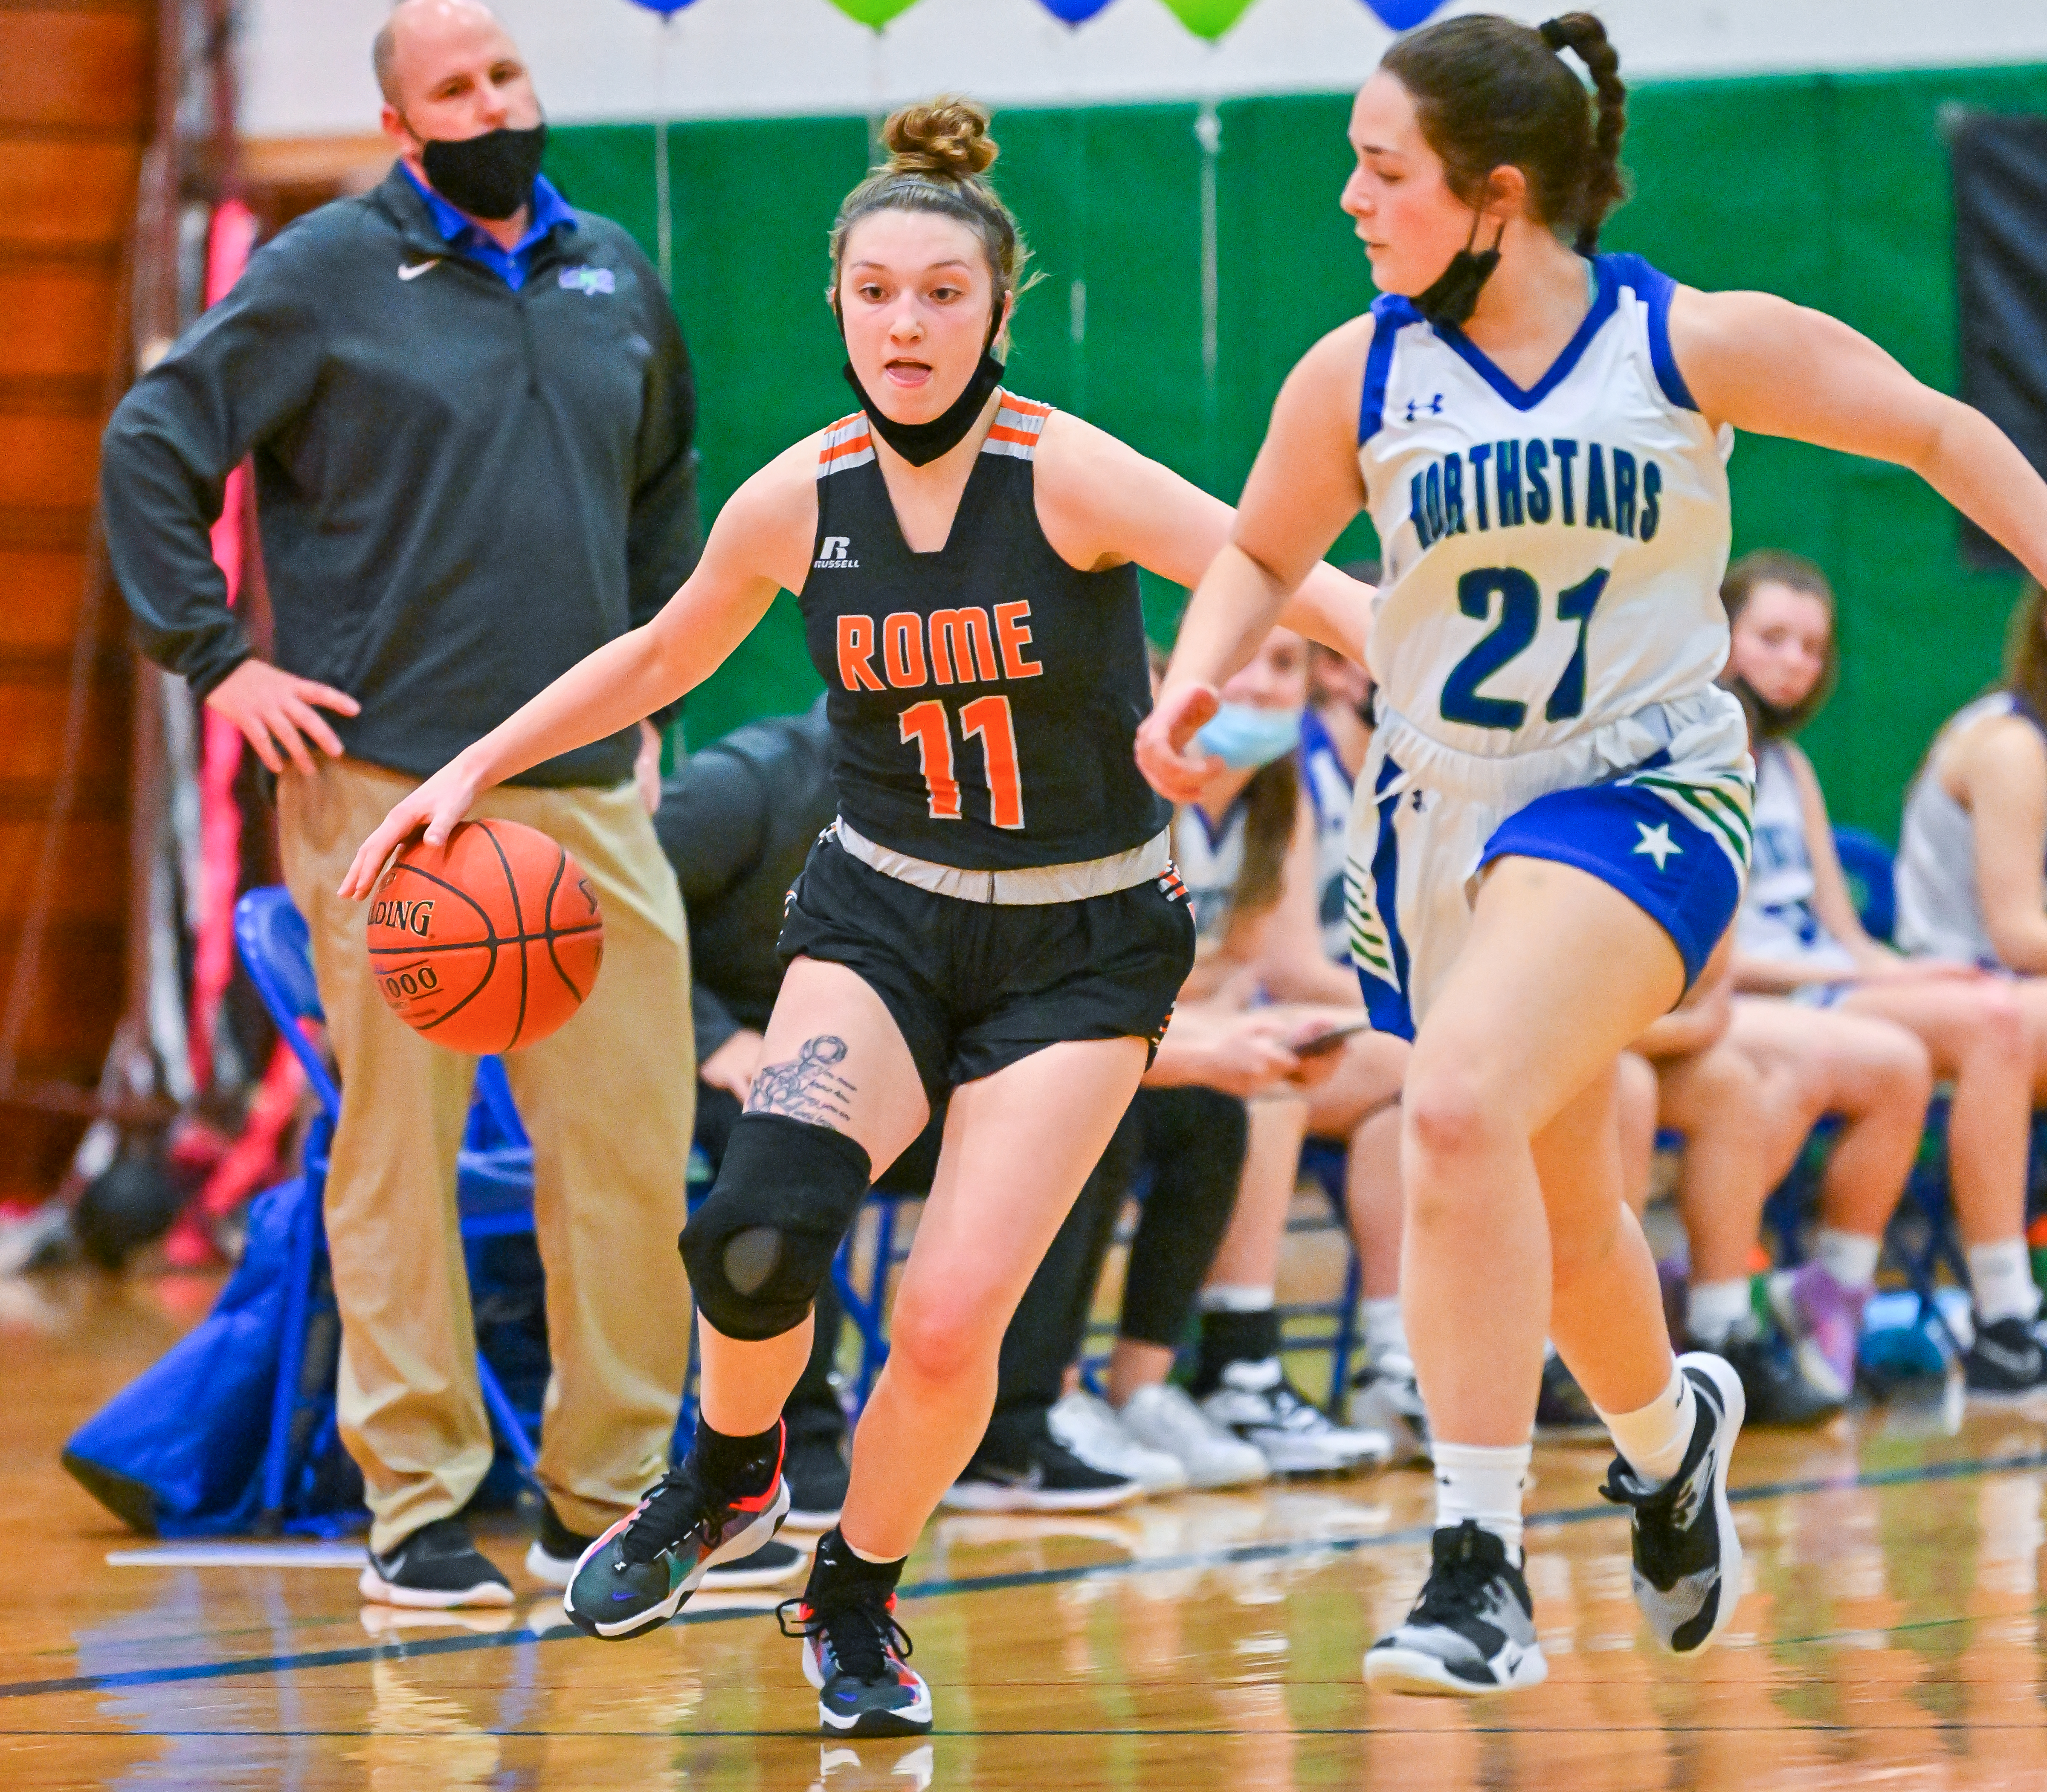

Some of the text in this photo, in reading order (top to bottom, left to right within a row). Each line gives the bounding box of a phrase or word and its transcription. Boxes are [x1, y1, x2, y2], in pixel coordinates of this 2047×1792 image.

[814, 559, 860, 568] RUSSELL
[837, 600, 1043, 691] ROME
[1440, 566, 1611, 731] 21
[899, 695, 1025, 829] 11
